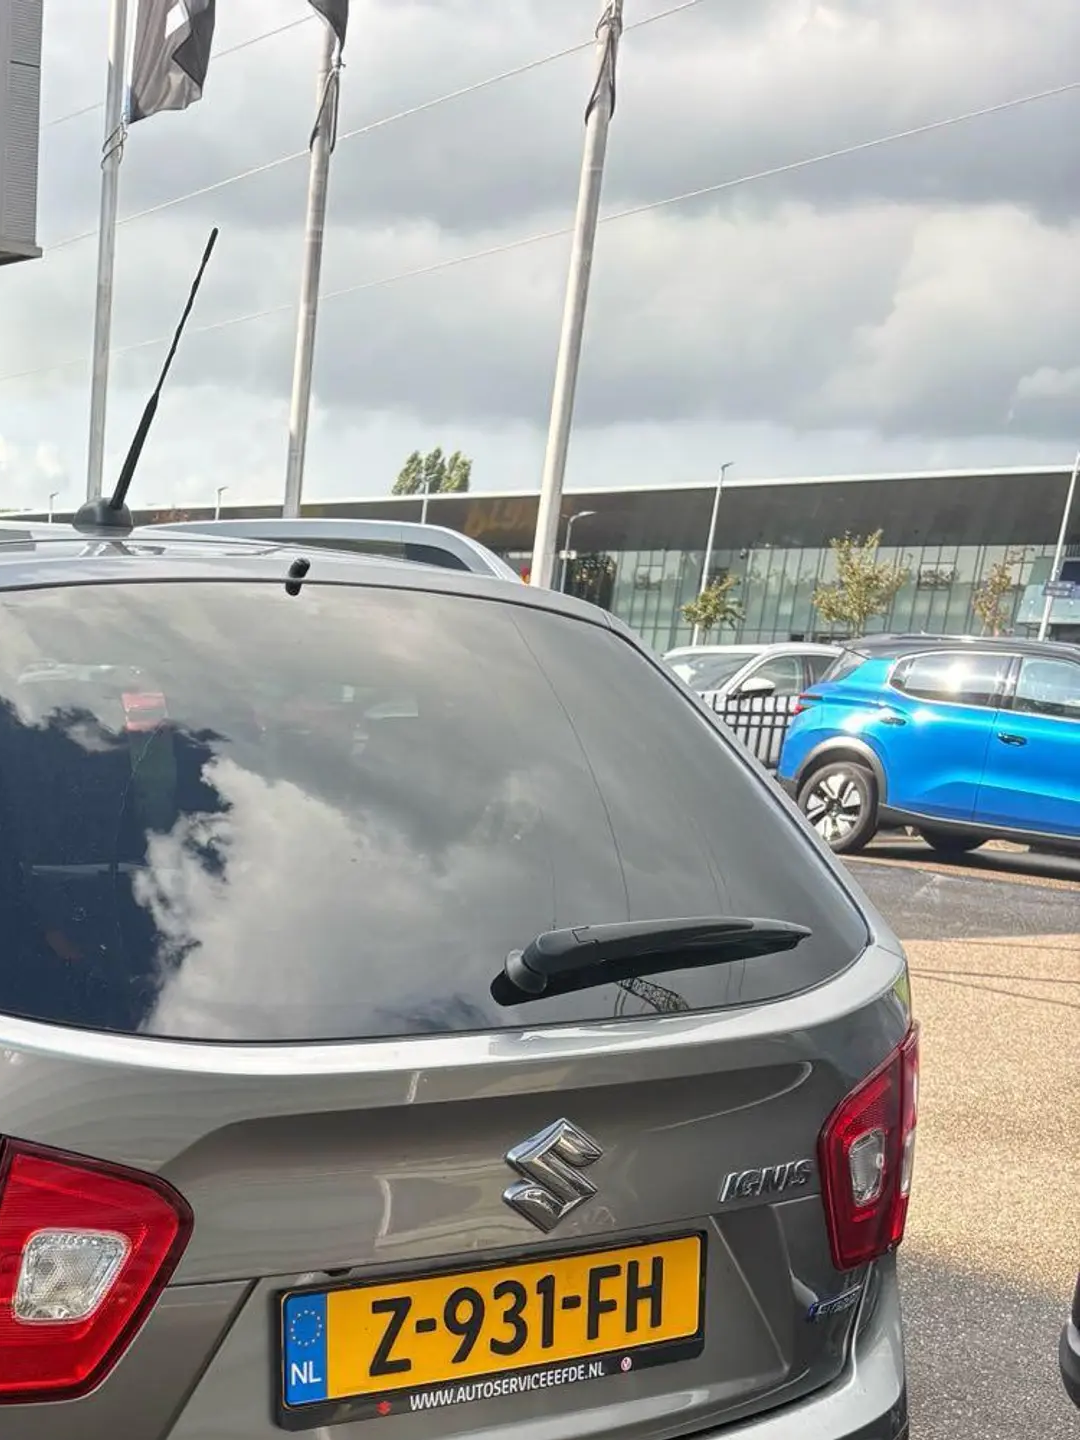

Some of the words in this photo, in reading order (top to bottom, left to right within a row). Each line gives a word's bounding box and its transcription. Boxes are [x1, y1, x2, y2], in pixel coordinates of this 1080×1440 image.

[718, 1158, 814, 1203] IGNIS
[369, 1256, 664, 1378] Z-931-FH
[290, 1360, 322, 1386] NL
[410, 1361, 605, 1411] WWW.AUTOSERVICEEEFDE.NL
